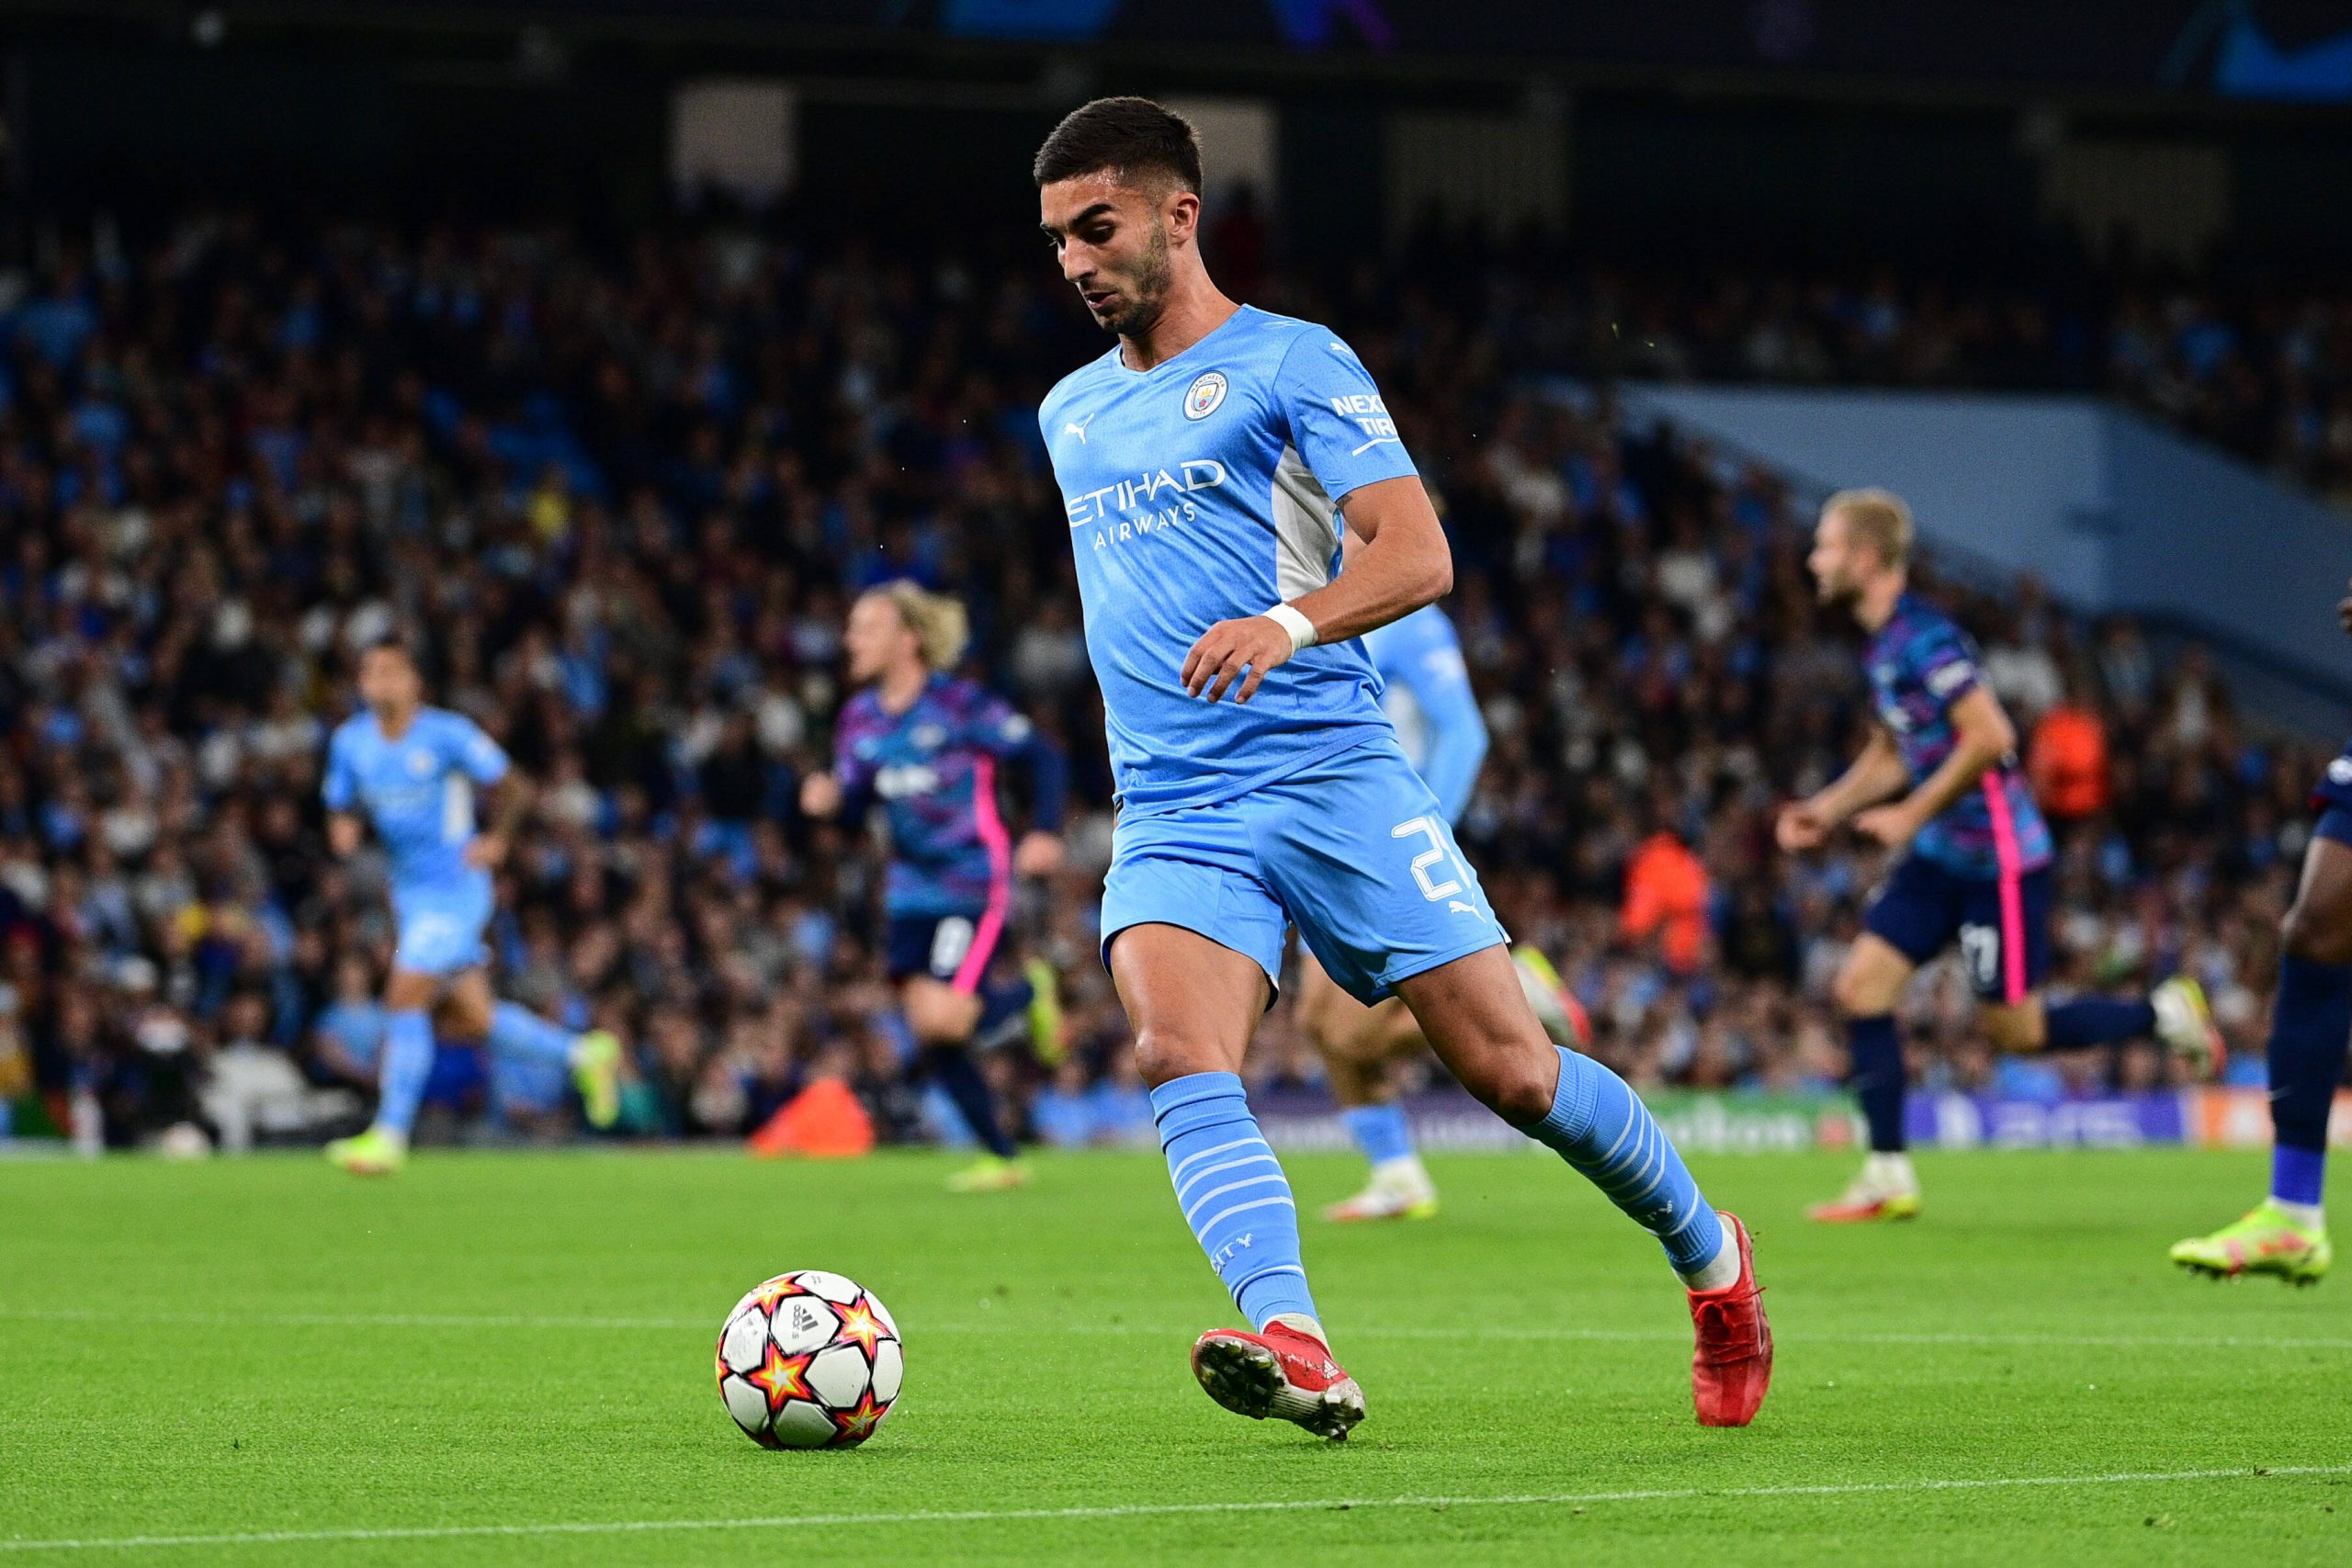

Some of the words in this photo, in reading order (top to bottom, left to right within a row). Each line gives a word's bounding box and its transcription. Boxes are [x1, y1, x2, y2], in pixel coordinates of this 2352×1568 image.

[1191, 375, 1226, 394] MANCHESTER
[1330, 395, 1388, 416] NEX
[1356, 417, 1397, 436] TIR
[1067, 459, 1227, 528] ETIHAD
[1093, 502, 1196, 551] AIRWAYS
[1210, 1233, 1253, 1277] CITY
